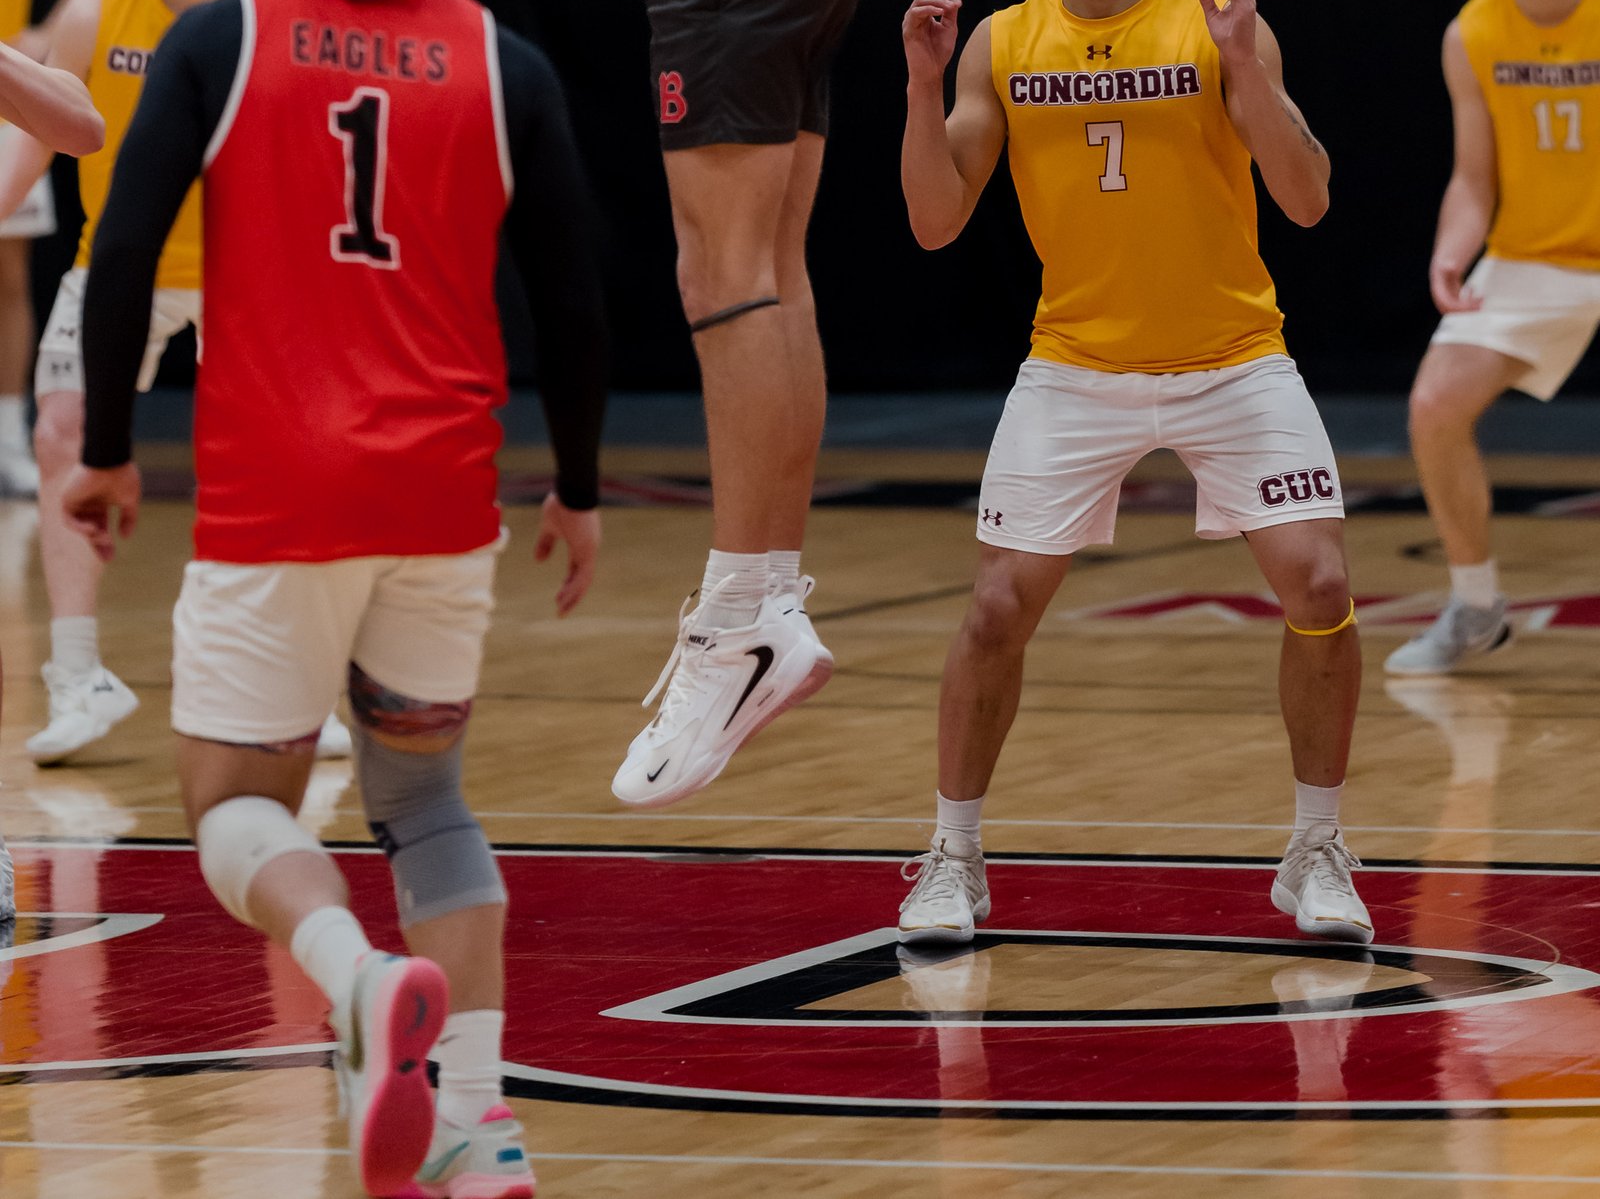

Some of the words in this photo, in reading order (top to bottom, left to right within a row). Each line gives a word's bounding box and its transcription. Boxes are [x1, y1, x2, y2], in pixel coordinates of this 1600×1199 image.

[291, 21, 450, 84] EAGLES
[658, 70, 688, 124] B
[1008, 62, 1202, 106] CONCORDIA
[1532, 99, 1584, 153] 17
[328, 86, 401, 270] 1
[1085, 121, 1127, 192] 7
[1257, 467, 1335, 508] CUC
